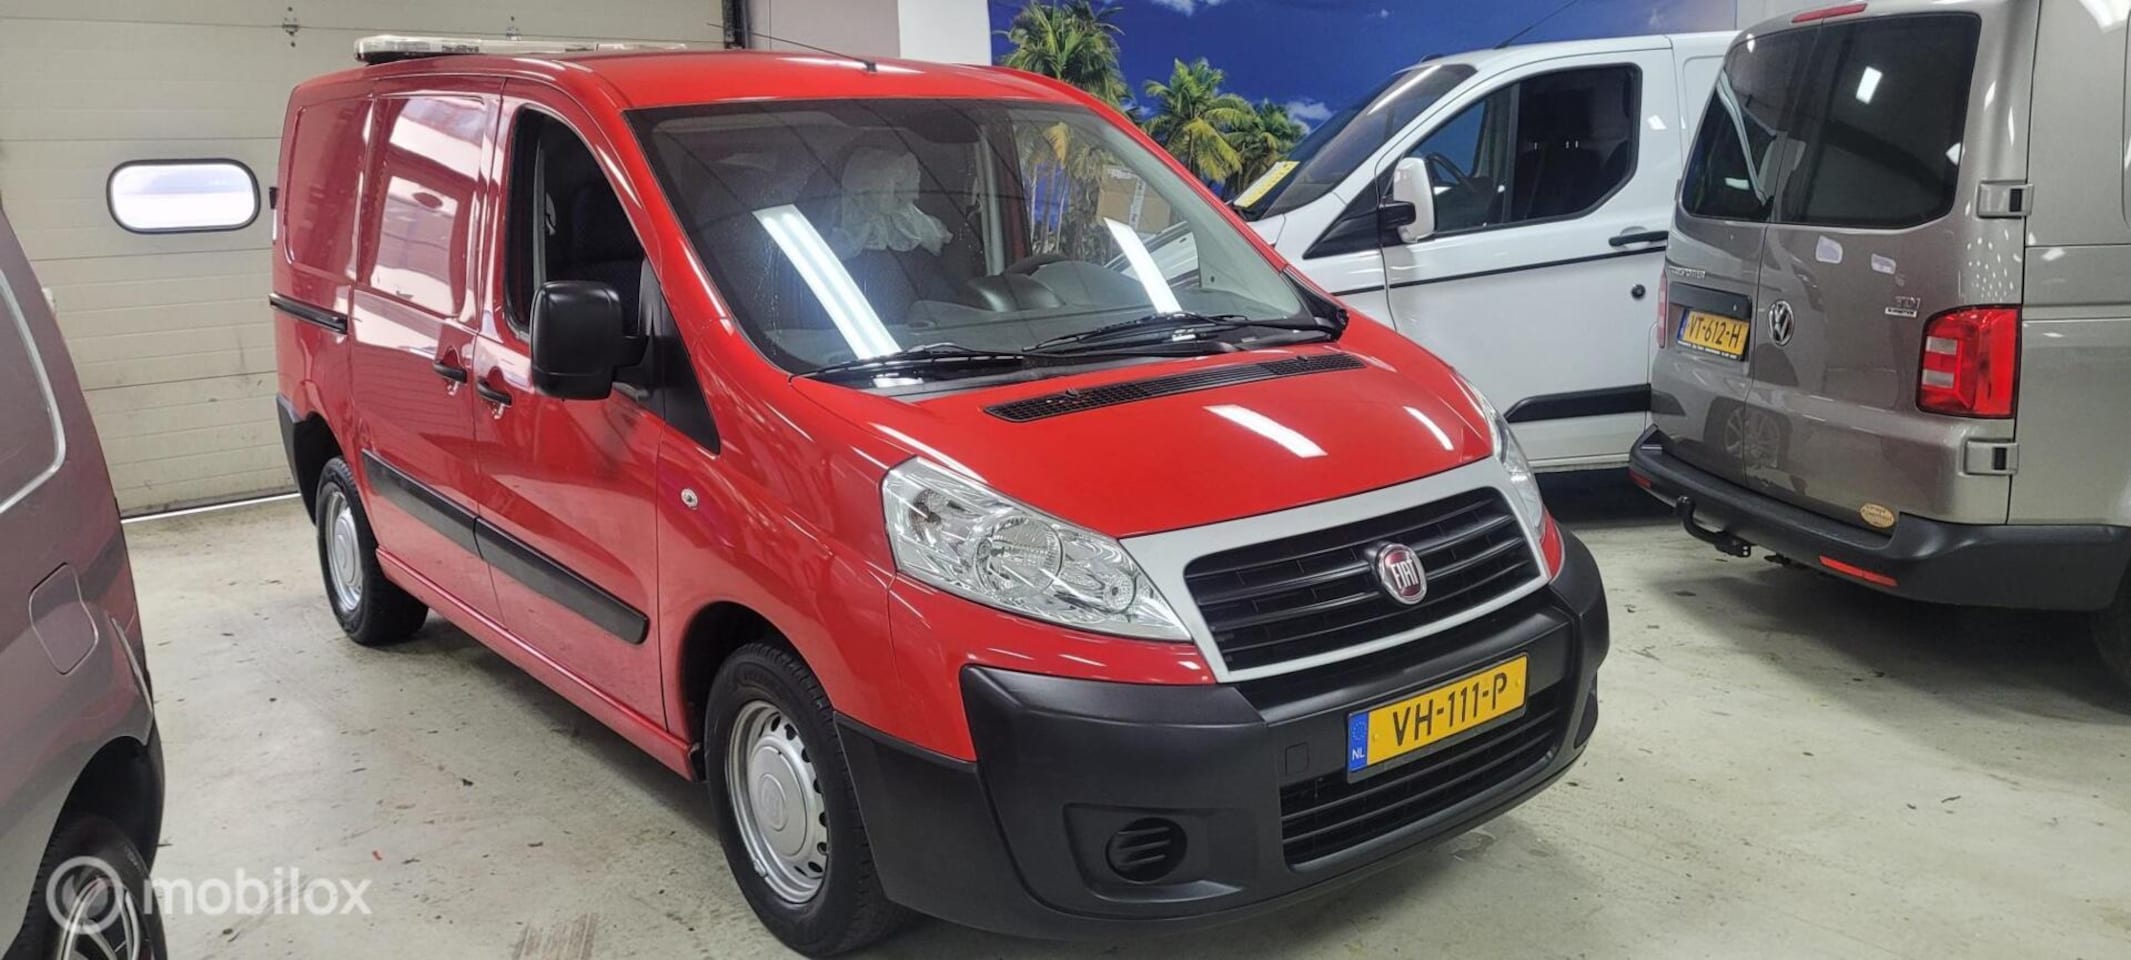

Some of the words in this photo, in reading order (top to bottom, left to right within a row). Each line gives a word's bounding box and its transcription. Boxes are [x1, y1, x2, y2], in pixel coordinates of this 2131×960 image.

[1688, 314, 1742, 349] VT-612-H
[1390, 560, 1419, 589] FIAT
[1392, 672, 1507, 746] VH-111-P
[1351, 748, 1366, 761] NL
